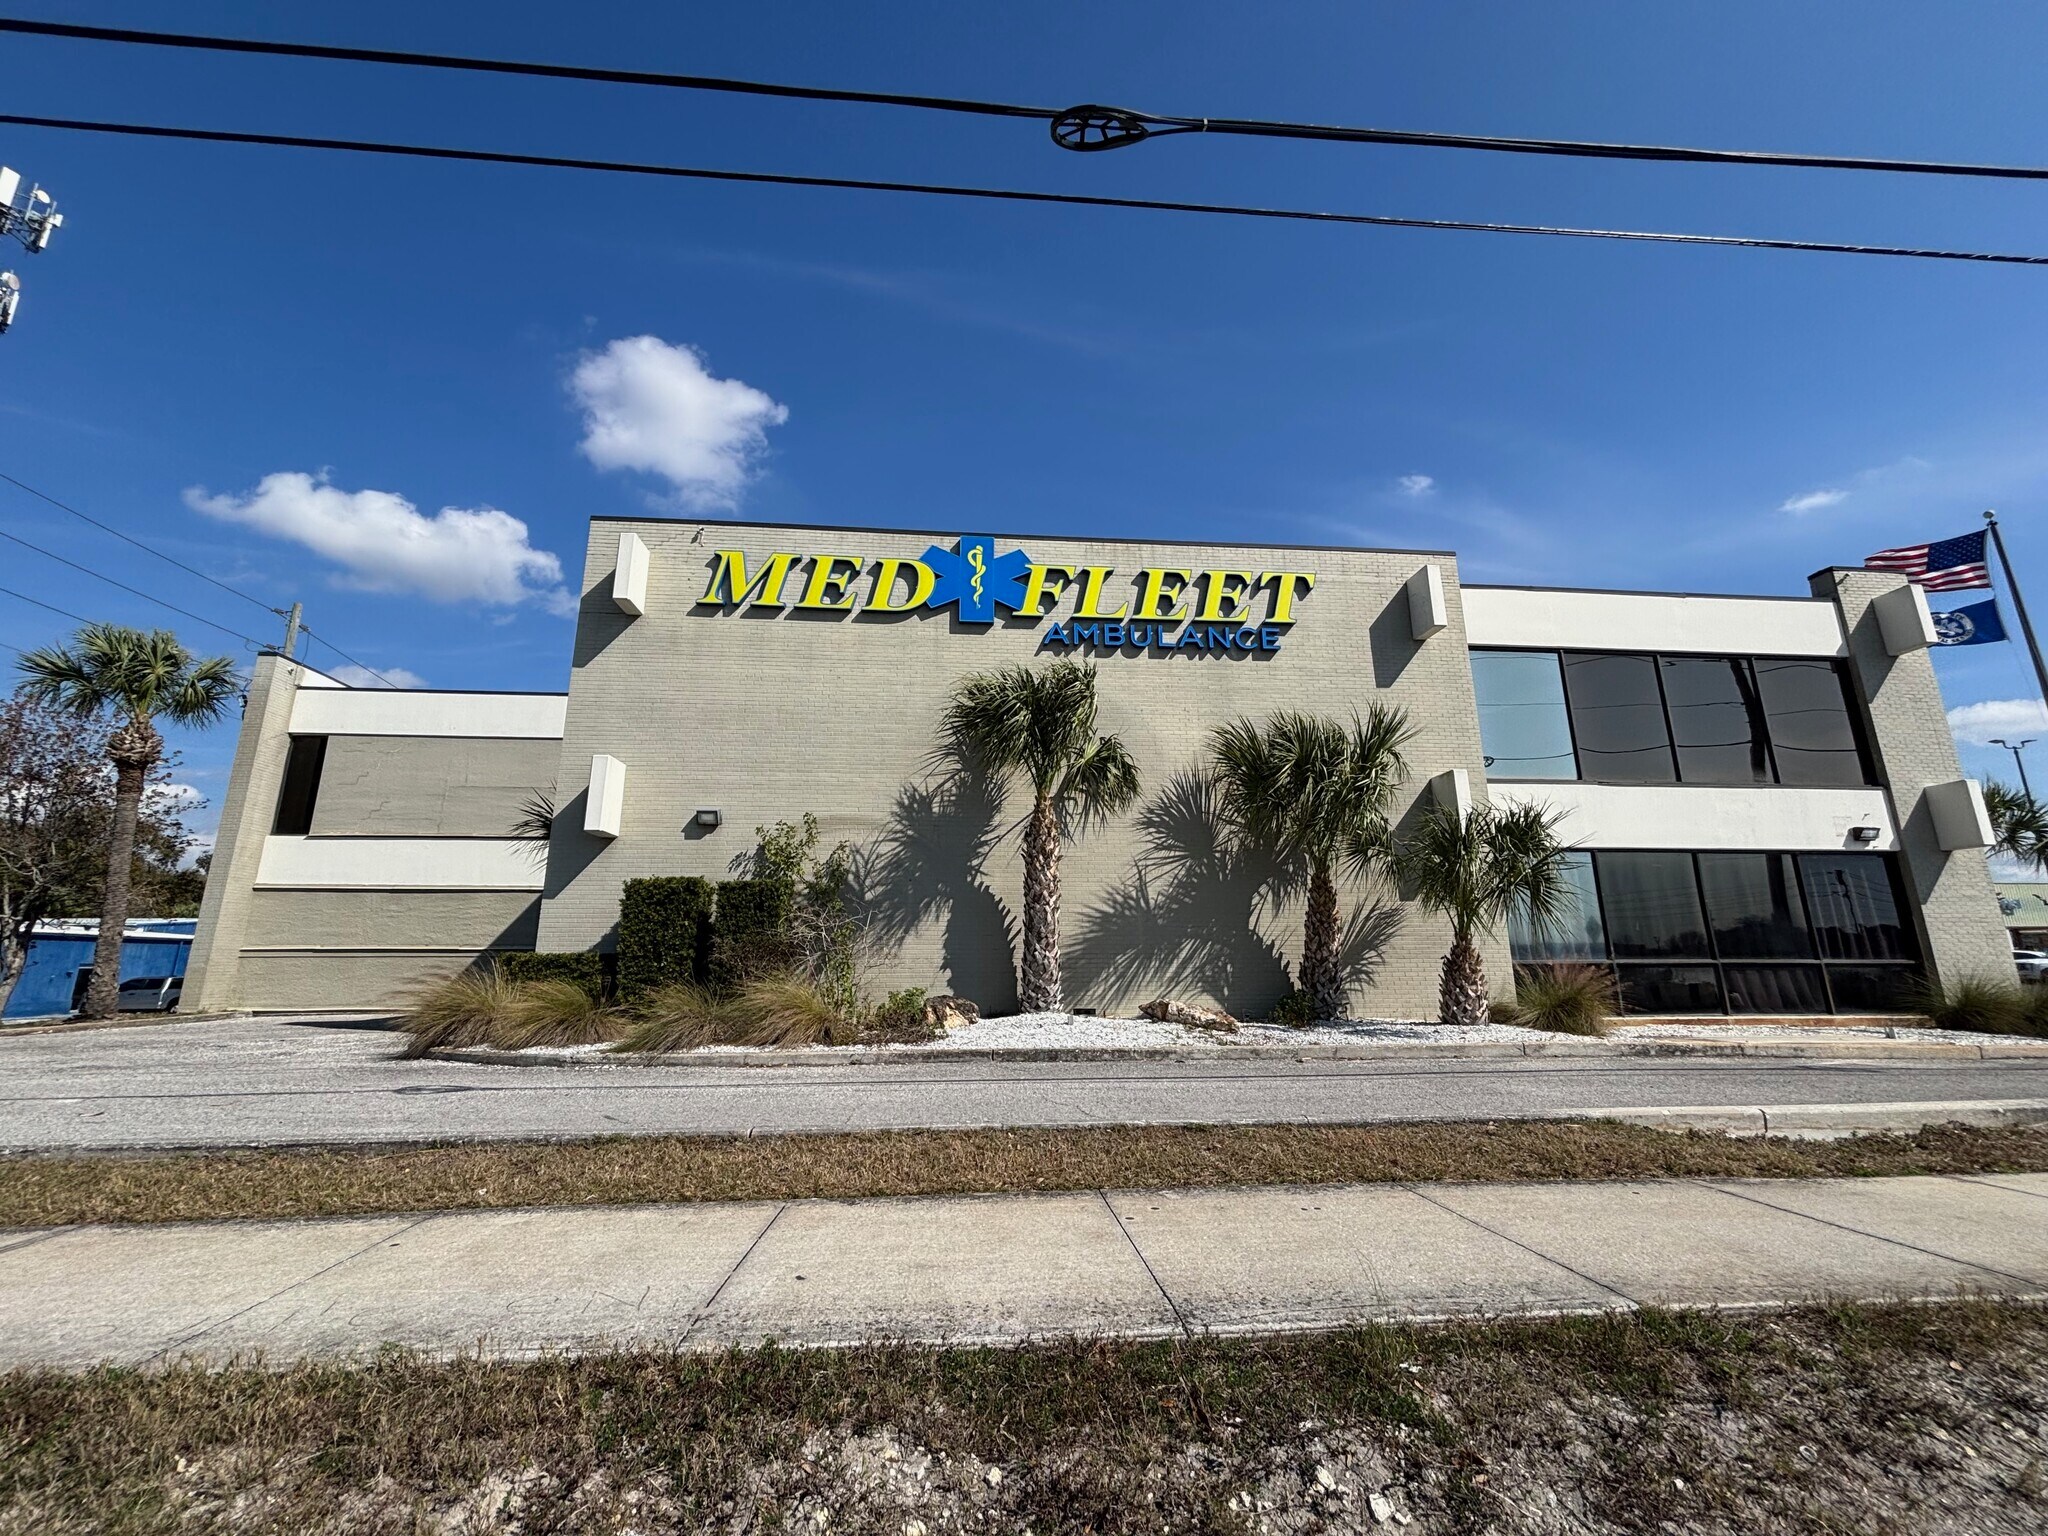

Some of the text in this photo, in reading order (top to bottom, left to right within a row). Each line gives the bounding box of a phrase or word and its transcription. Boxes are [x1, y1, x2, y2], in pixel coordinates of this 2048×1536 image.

[696, 550, 1316, 624] MED FLEET
[1043, 622, 1282, 650] AMBULANCE
